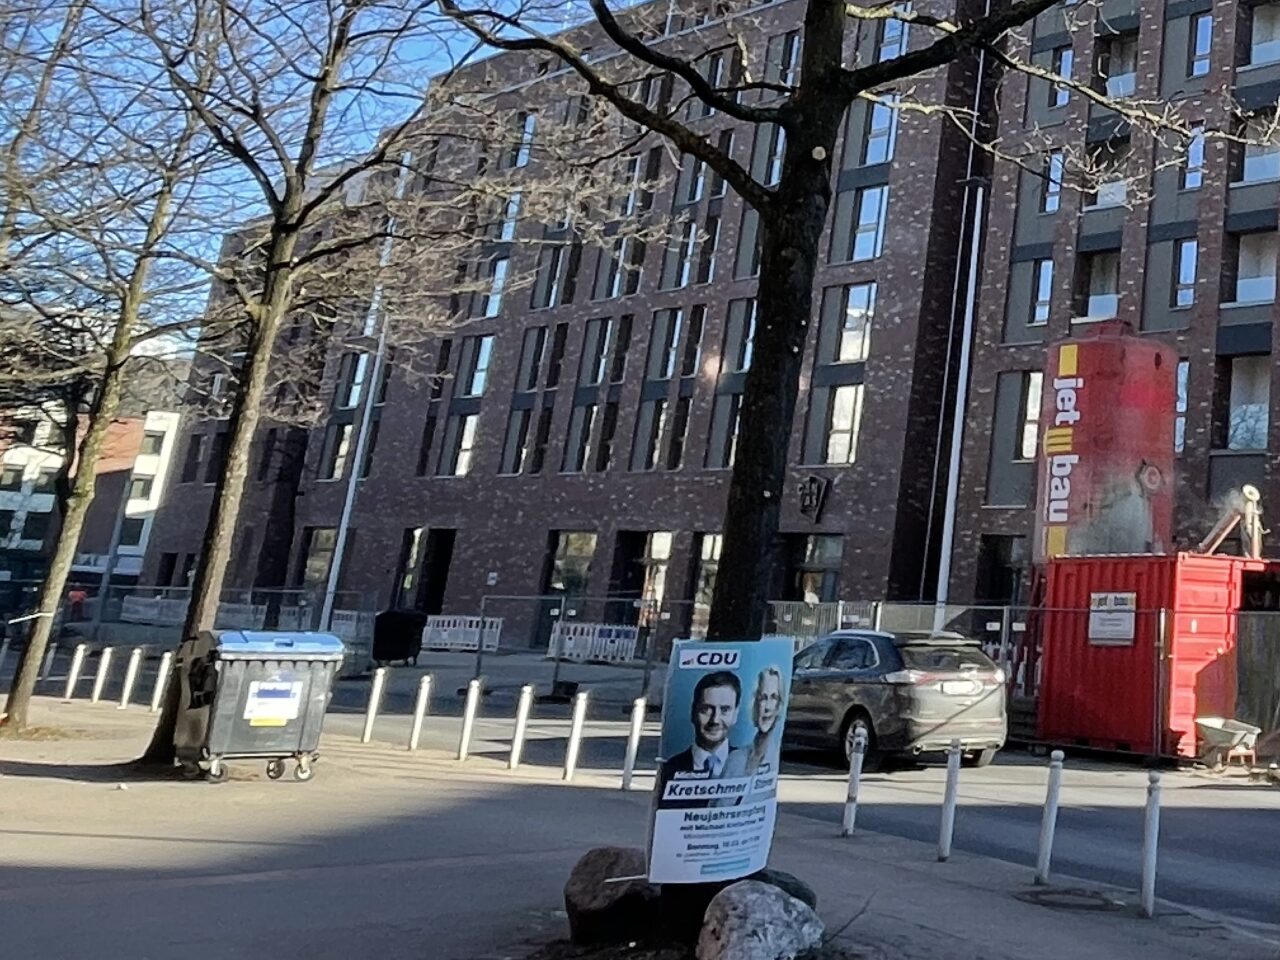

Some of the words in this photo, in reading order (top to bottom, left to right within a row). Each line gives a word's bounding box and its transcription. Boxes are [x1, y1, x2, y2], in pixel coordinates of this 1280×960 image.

[1053, 377, 1084, 426] jet
[1048, 454, 1080, 522] bau
[697, 652, 738, 665] CDU
[667, 783, 748, 796] Kretschmer
